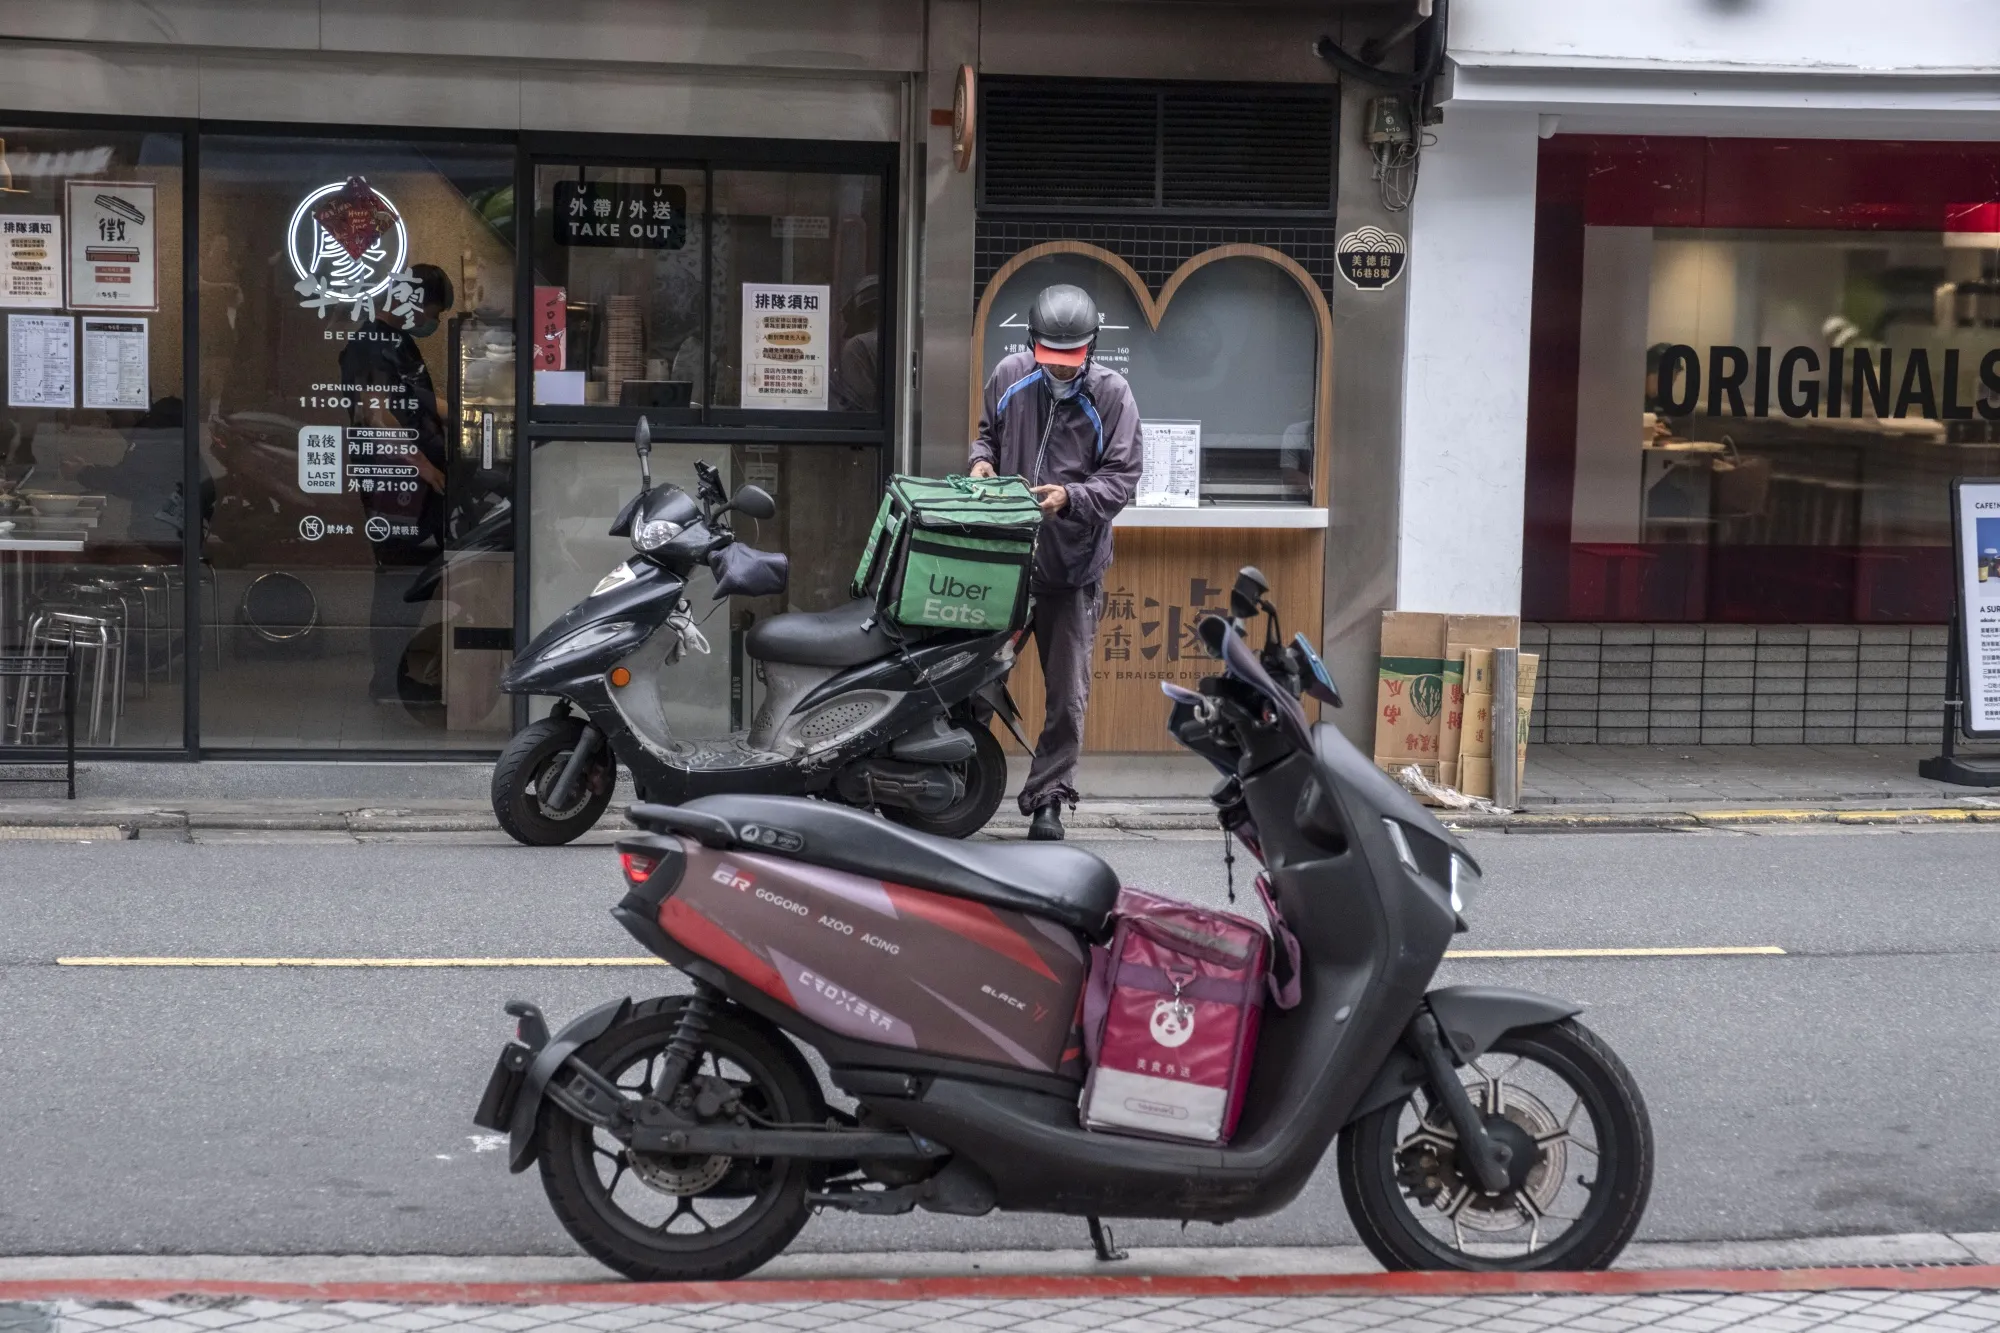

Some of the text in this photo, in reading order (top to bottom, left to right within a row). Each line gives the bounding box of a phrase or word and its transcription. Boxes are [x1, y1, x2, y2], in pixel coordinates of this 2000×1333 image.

[3, 221, 52, 234] 排隊須知
[99, 217, 126, 242] 徵
[568, 222, 671, 239] TAKE OUT
[1351, 254, 1392, 267] 美德街
[1351, 268, 1390, 279] 16巷8號
[755, 293, 819, 310] 排隊須知
[323, 330, 402, 343] BEEFULL
[1120, 367, 1129, 375] 50
[311, 383, 407, 393] OPENING HOURS
[1657, 344, 2000, 421] ORIGINALS
[299, 396, 352, 408] 11:00
[369, 398, 420, 410] 21:15
[356, 430, 375, 438] FOR
[376, 430, 396, 438] DINE
[306, 434, 336, 449] 最後
[348, 442, 418, 456] 內用 20:50
[306, 451, 336, 466] 點餐
[307, 471, 336, 480] LAST
[353, 467, 371, 475] FOR
[372, 467, 394, 475] TAKE
[306, 480, 336, 488] ORDER
[347, 478, 418, 492] 外帶 21:00
[326, 524, 354, 535] 禁外食
[391, 525, 419, 536] 禁吸菸
[928, 573, 993, 601] Uber
[922, 597, 986, 624] Eats
[755, 888, 809, 917] GOGORO
[980, 984, 1026, 1010] BLACK
[1137, 1058, 1191, 1078] 美食外送
